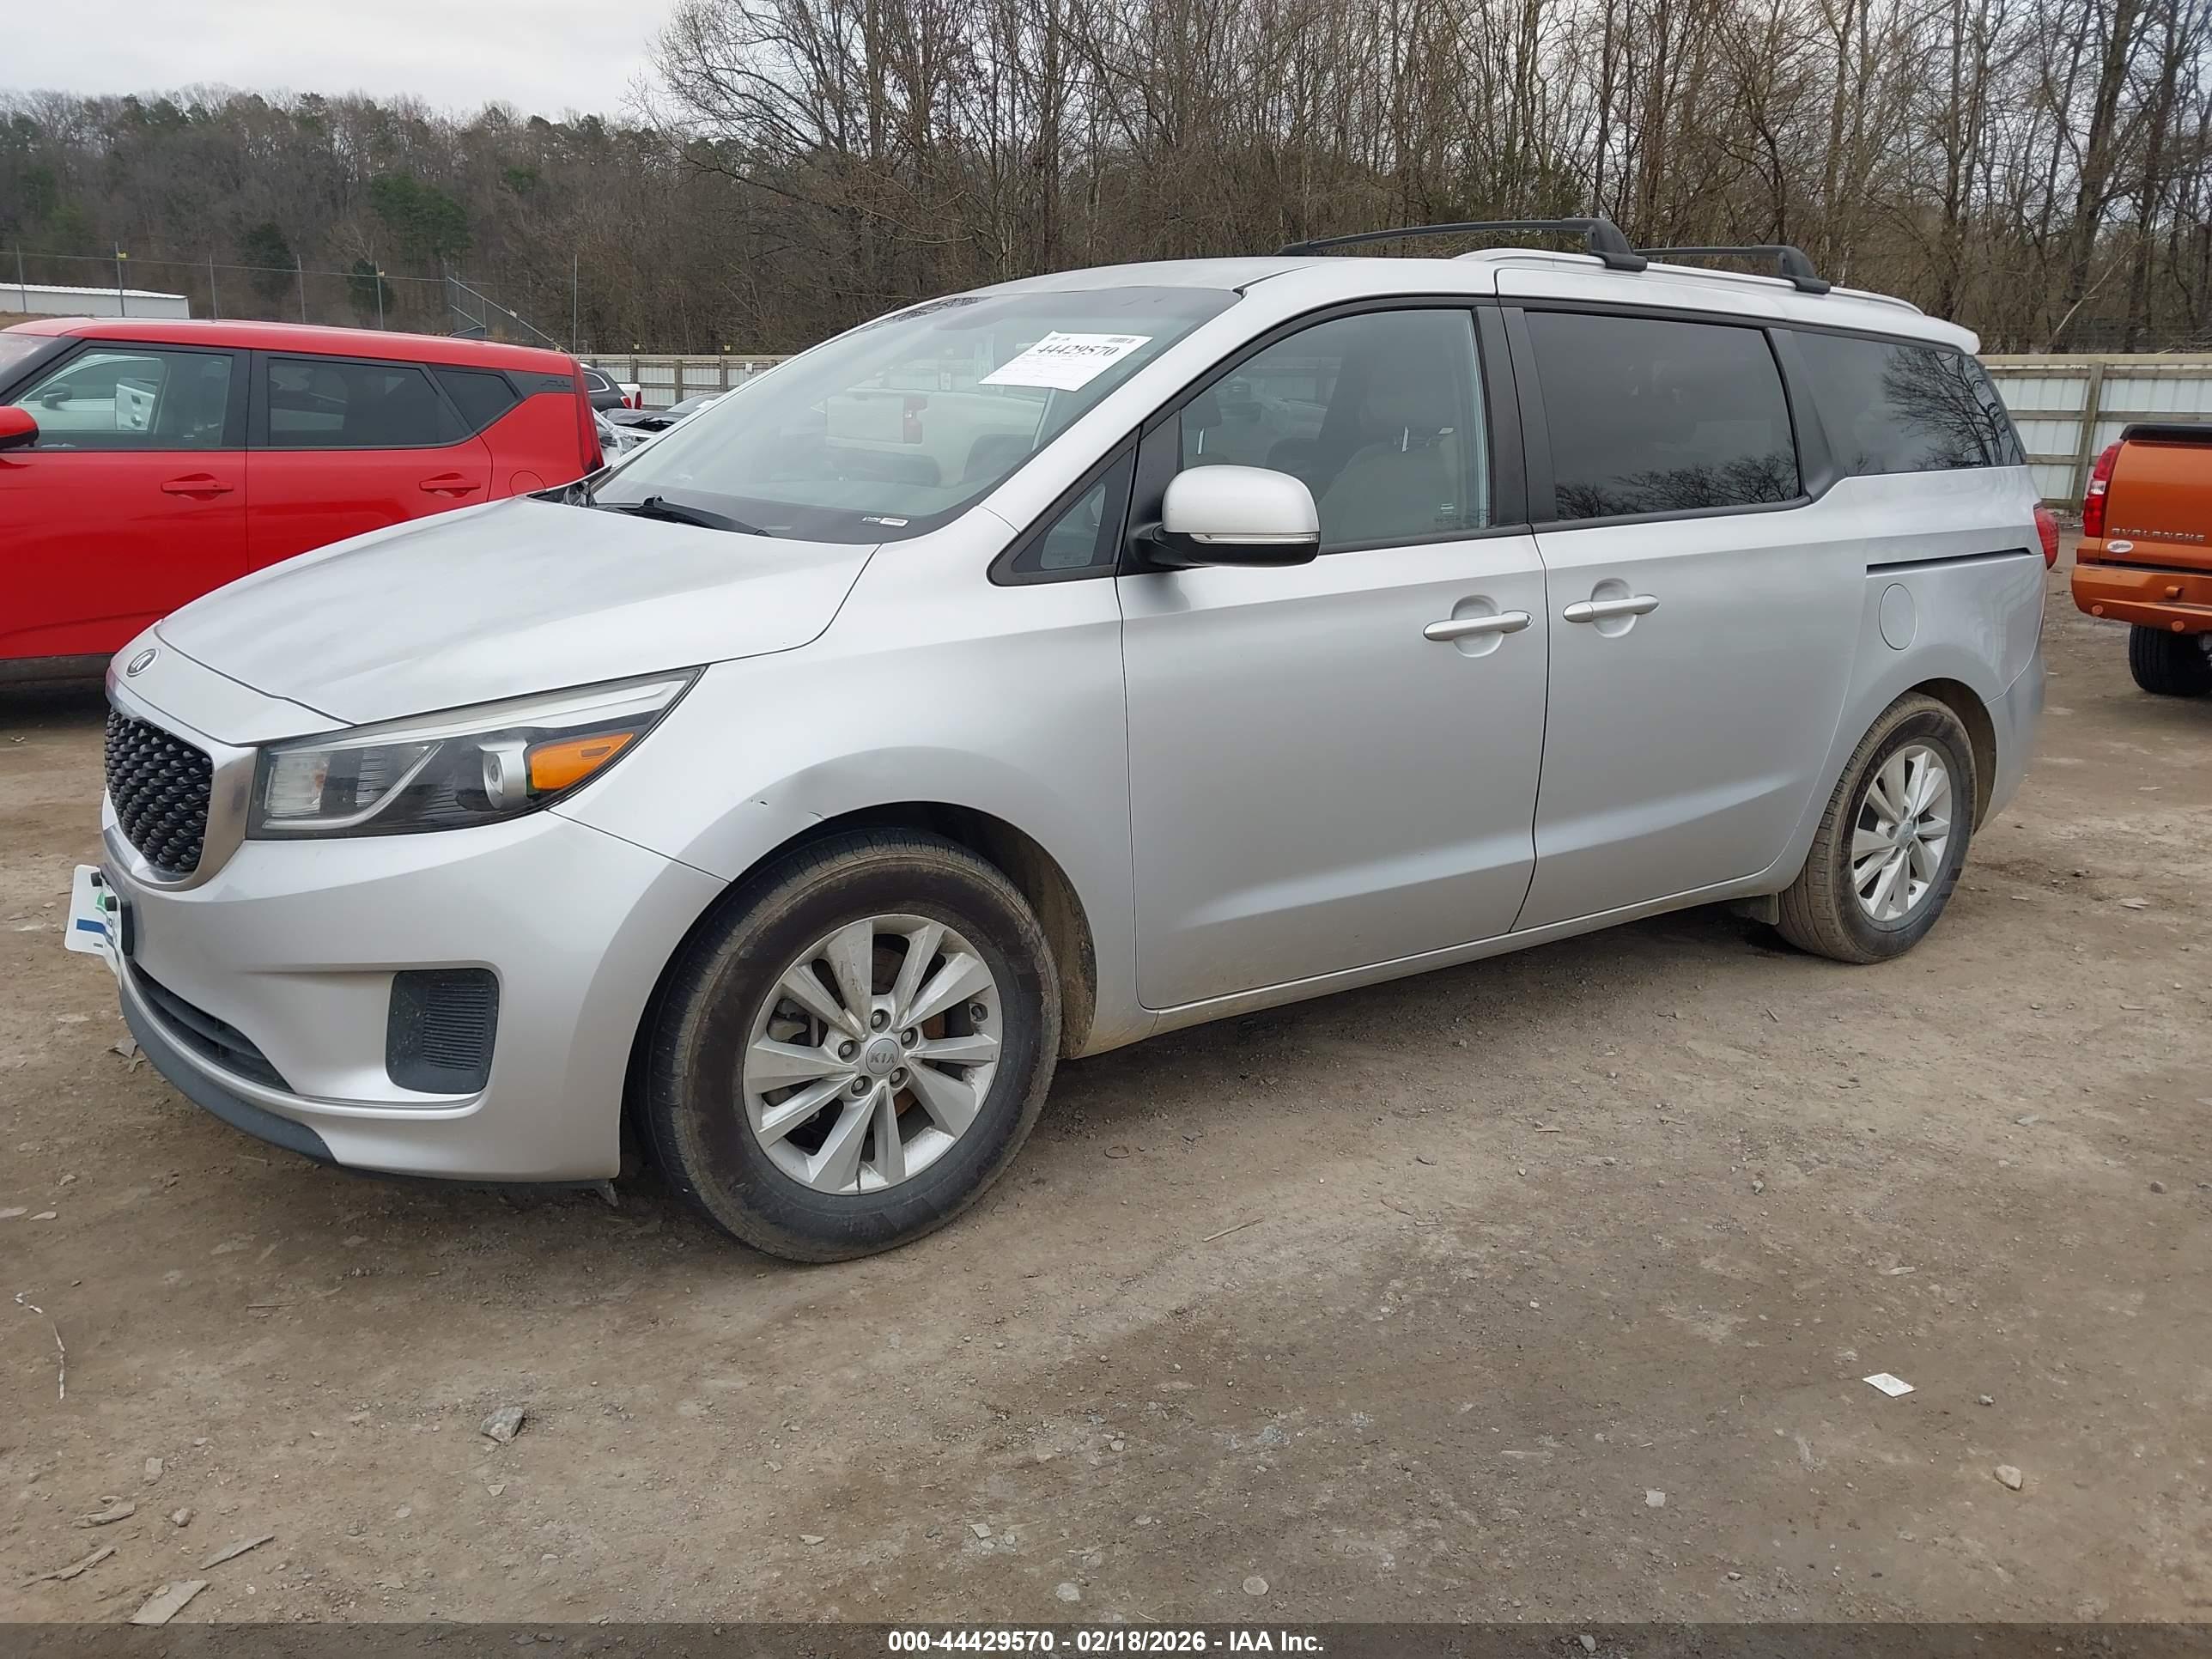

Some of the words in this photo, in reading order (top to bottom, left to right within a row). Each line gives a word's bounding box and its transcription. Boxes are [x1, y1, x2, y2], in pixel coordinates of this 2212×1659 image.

[1036, 343, 1120, 357] 44429570
[2112, 527, 2206, 542] AVALANCHE
[870, 1052, 895, 1064] KIA
